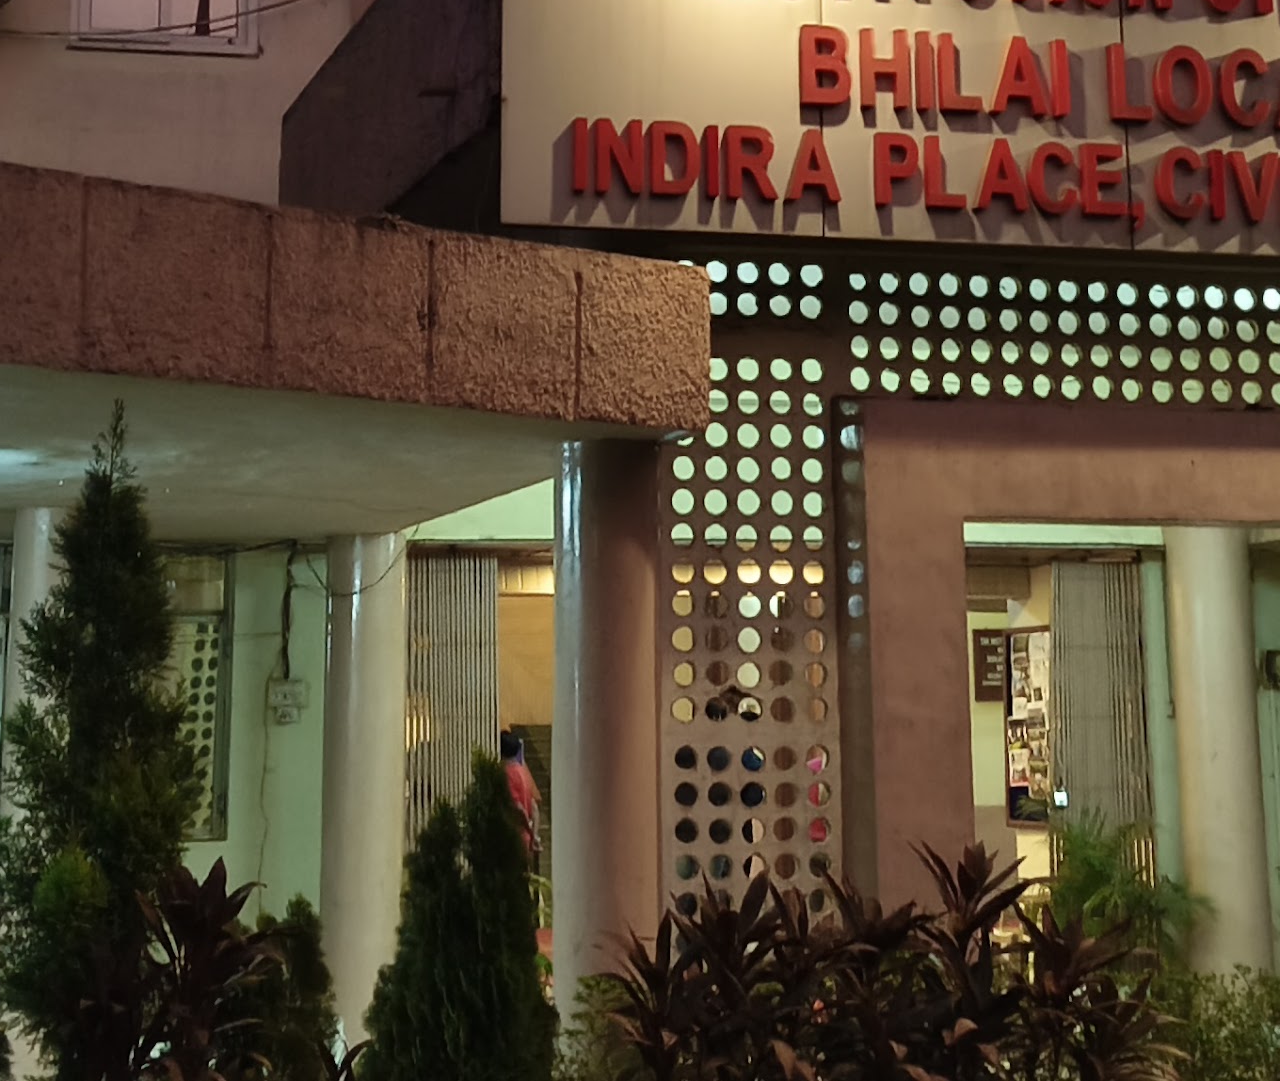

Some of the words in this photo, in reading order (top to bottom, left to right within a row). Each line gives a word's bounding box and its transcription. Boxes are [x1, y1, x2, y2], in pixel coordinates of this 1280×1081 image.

[799, 24, 1071, 119] BHILAI
[572, 117, 842, 203] INDIRA
[873, 131, 1145, 231] PLACE,
